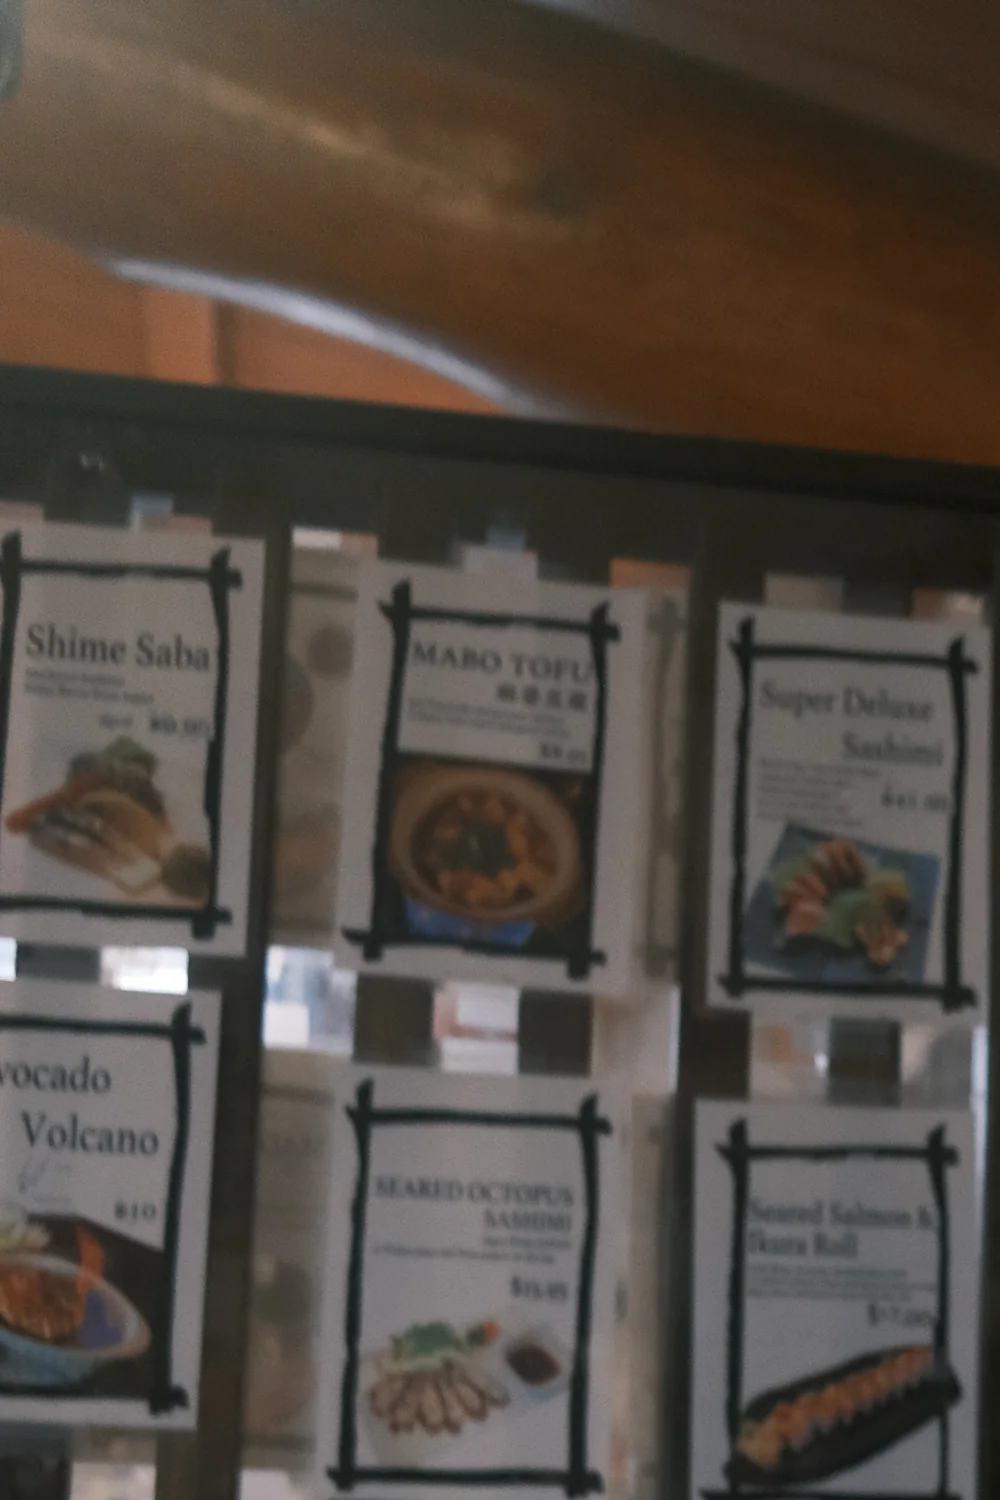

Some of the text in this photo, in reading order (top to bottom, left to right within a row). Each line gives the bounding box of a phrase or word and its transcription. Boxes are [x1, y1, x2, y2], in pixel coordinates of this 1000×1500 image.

[26, 622, 209, 671] Shime Saba
[413, 641, 594, 683] MABO TOFU
[760, 678, 837, 721] Super
[20, 1110, 159, 1155] Volcano
